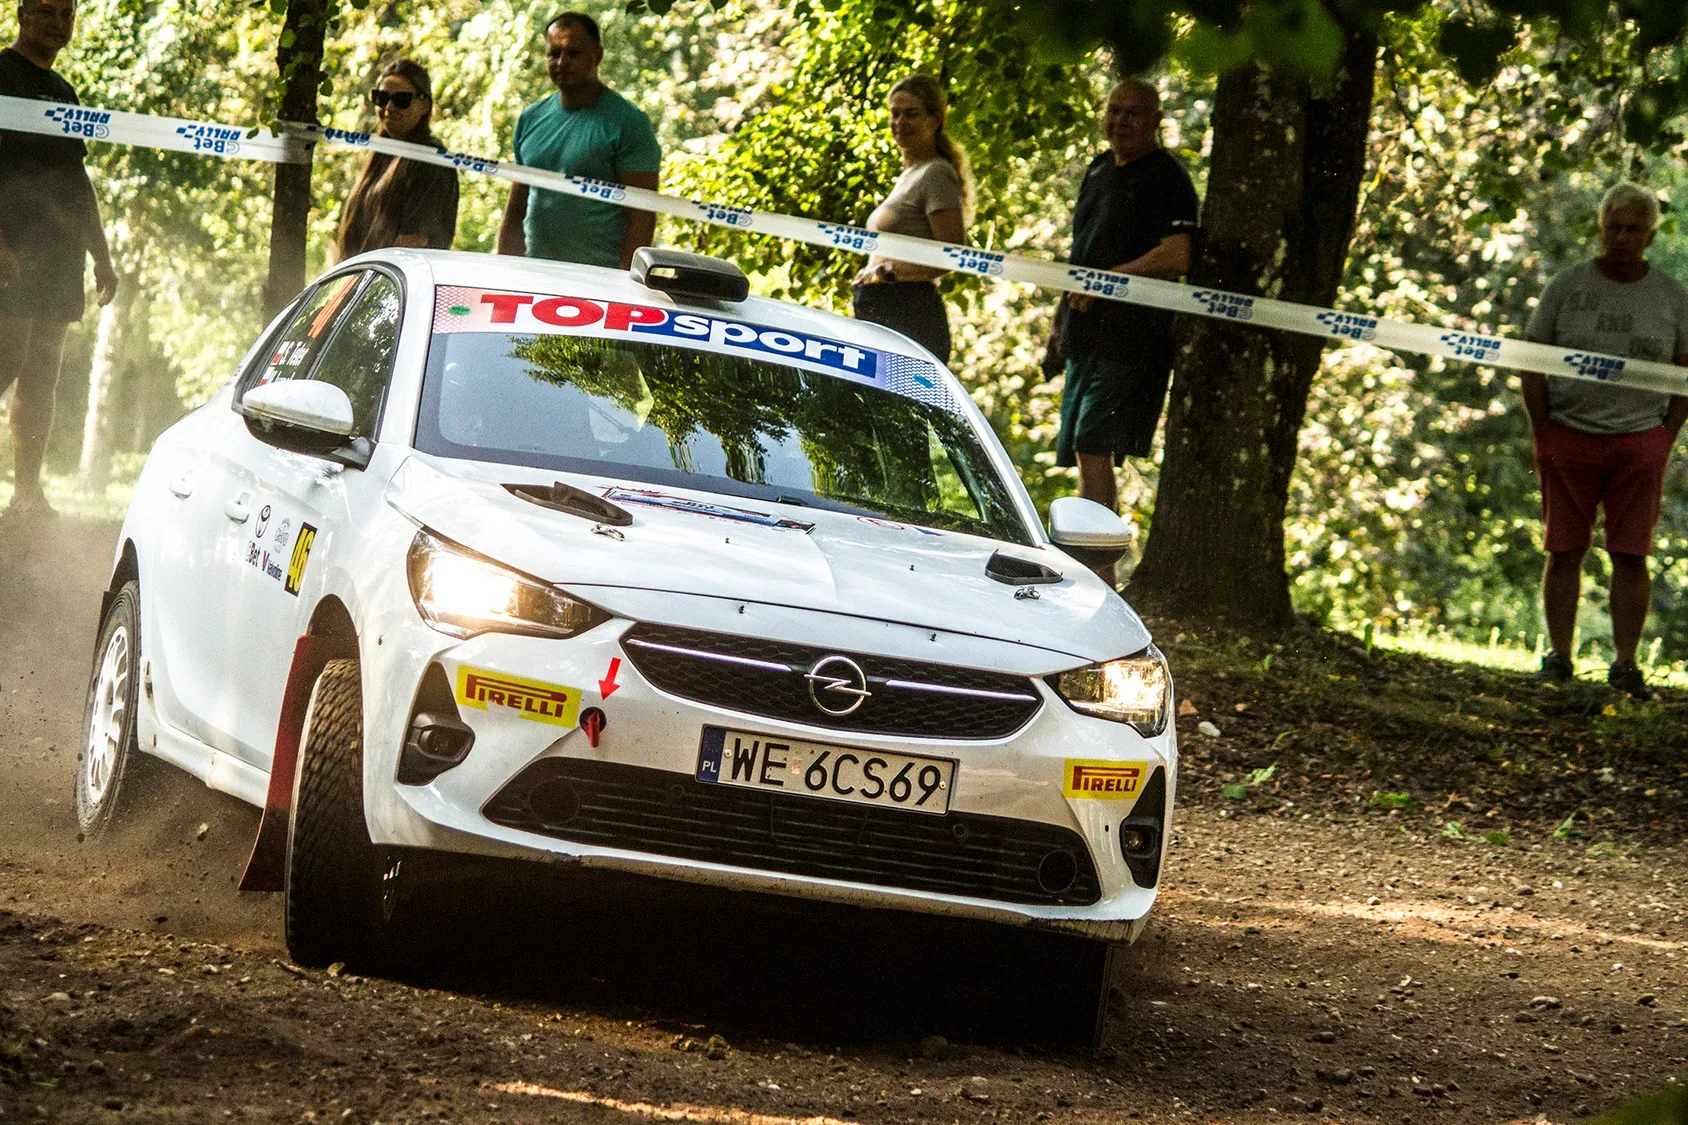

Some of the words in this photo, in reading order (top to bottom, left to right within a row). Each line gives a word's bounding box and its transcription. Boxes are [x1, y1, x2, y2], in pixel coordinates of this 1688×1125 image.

[63, 108, 111, 124] RALLY
[63, 120, 109, 139] CBet
[195, 125, 241, 141] RALLY
[194, 136, 240, 154] CBet
[579, 184, 626, 201] CBet
[707, 209, 752, 227] CBet
[833, 233, 878, 251] CBet
[958, 257, 1004, 275] CBet
[1083, 279, 1129, 298] CBet
[1207, 302, 1253, 319] CBet
[1331, 323, 1376, 340] CBet
[1455, 345, 1500, 361] CBet
[288, 528, 315, 592] 46
[466, 674, 567, 718] PIRELLI
[702, 761, 717, 773] PL
[731, 738, 790, 786] WE
[804, 750, 942, 805] 6CS69
[1072, 766, 1140, 792] PIRELLI
